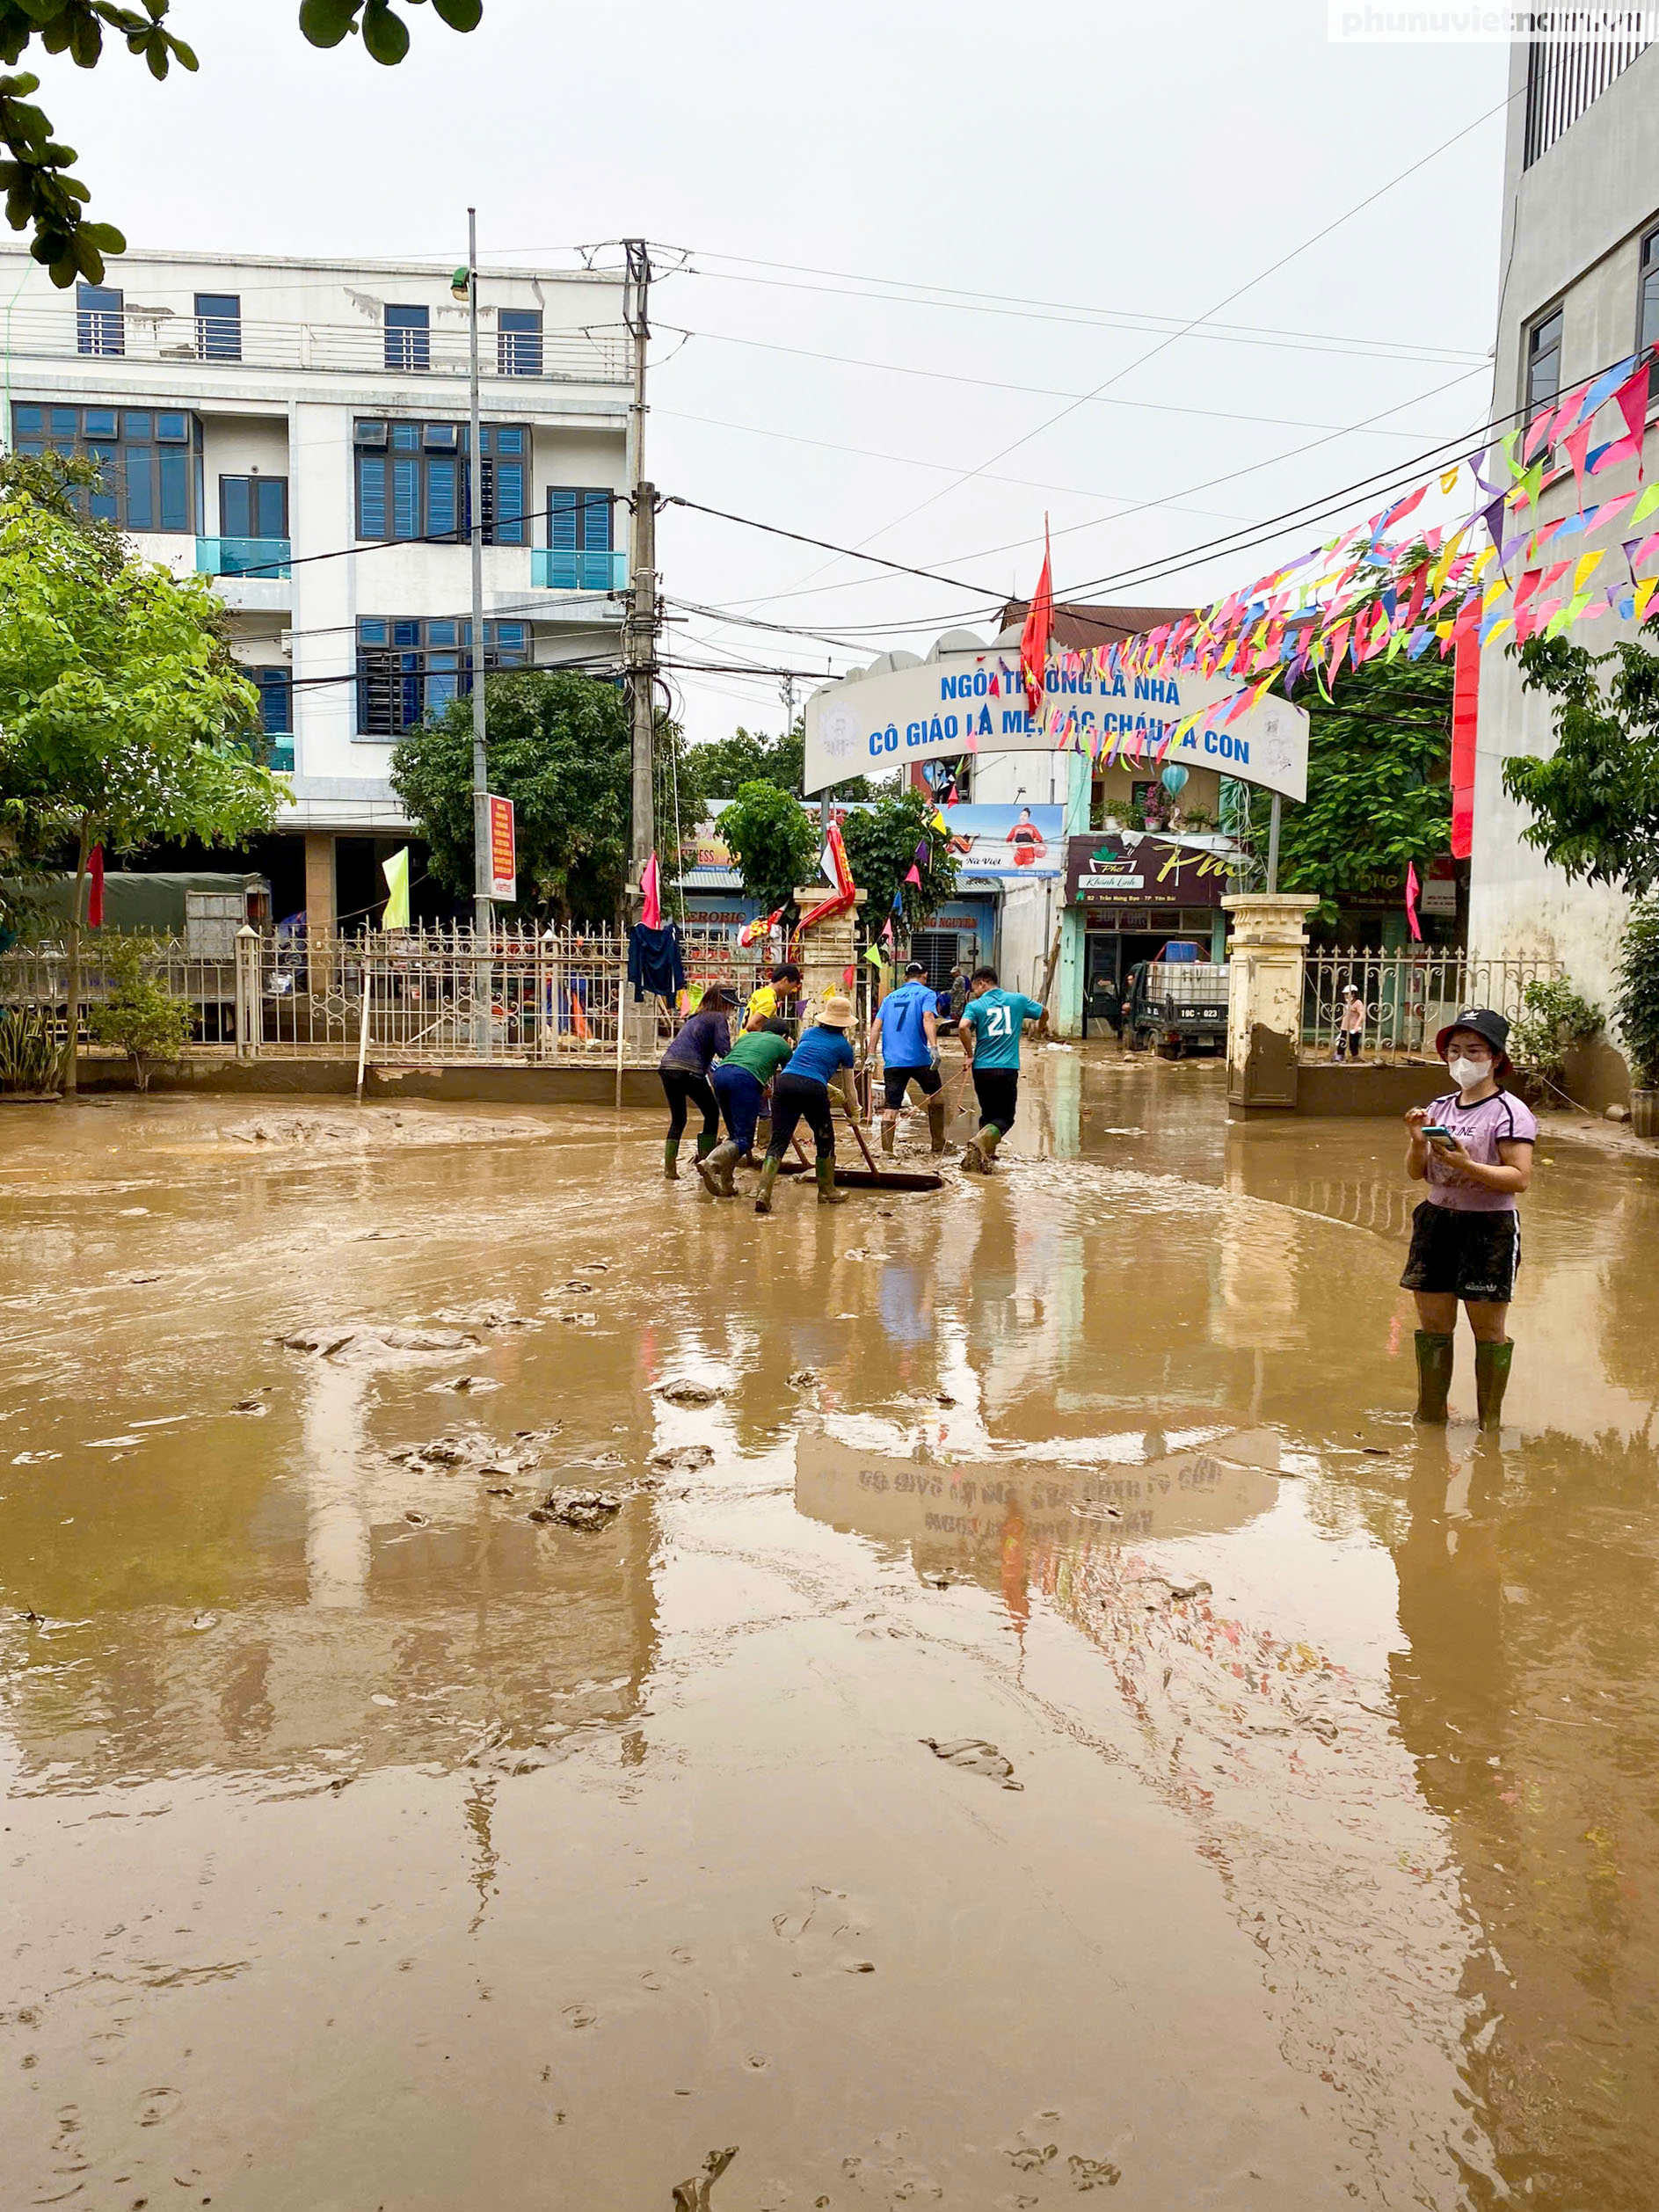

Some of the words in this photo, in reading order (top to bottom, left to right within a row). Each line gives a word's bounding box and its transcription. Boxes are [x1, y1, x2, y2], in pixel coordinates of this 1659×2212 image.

[1100, 669, 1127, 696] LÀ
[1134, 675, 1180, 706] NHÀ
[869, 723, 898, 756] CÔ
[906, 712, 958, 747] GIÁO
[1204, 729, 1249, 765] CON
[1087, 877, 1115, 887] Khánh
[1117, 877, 1135, 887] Linh
[893, 1000, 911, 1032] 7
[986, 1005, 1012, 1037] 21
